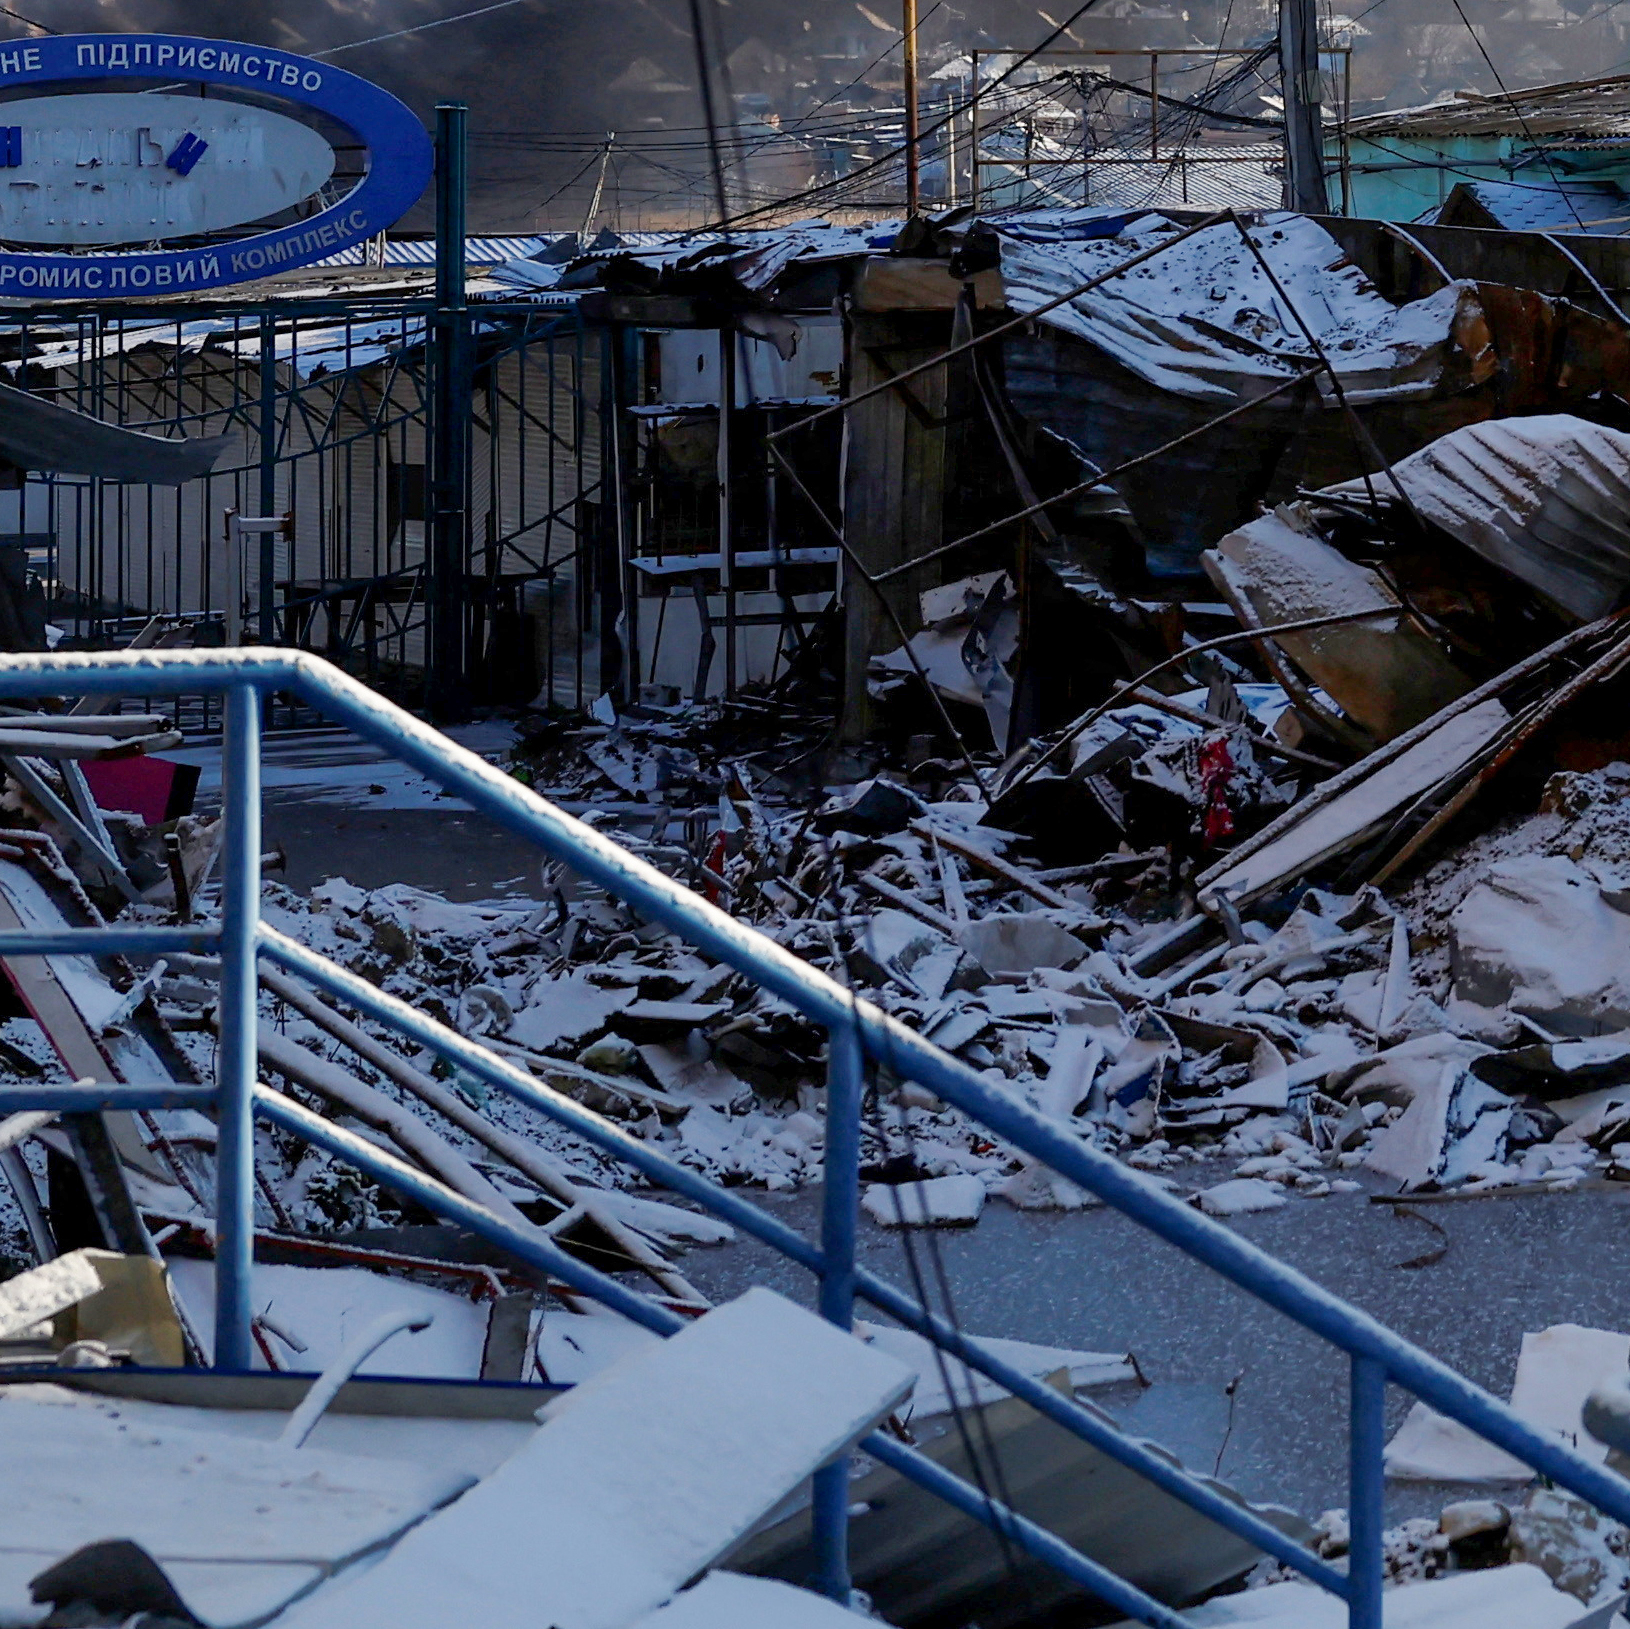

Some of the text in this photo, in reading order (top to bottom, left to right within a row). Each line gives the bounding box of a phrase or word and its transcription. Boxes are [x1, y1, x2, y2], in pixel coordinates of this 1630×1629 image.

[77, 43, 323, 92] ПІДПРИЄМСТВО
[0, 210, 368, 289] РОМИСЛОВИЙ КОМПЛЕКС
